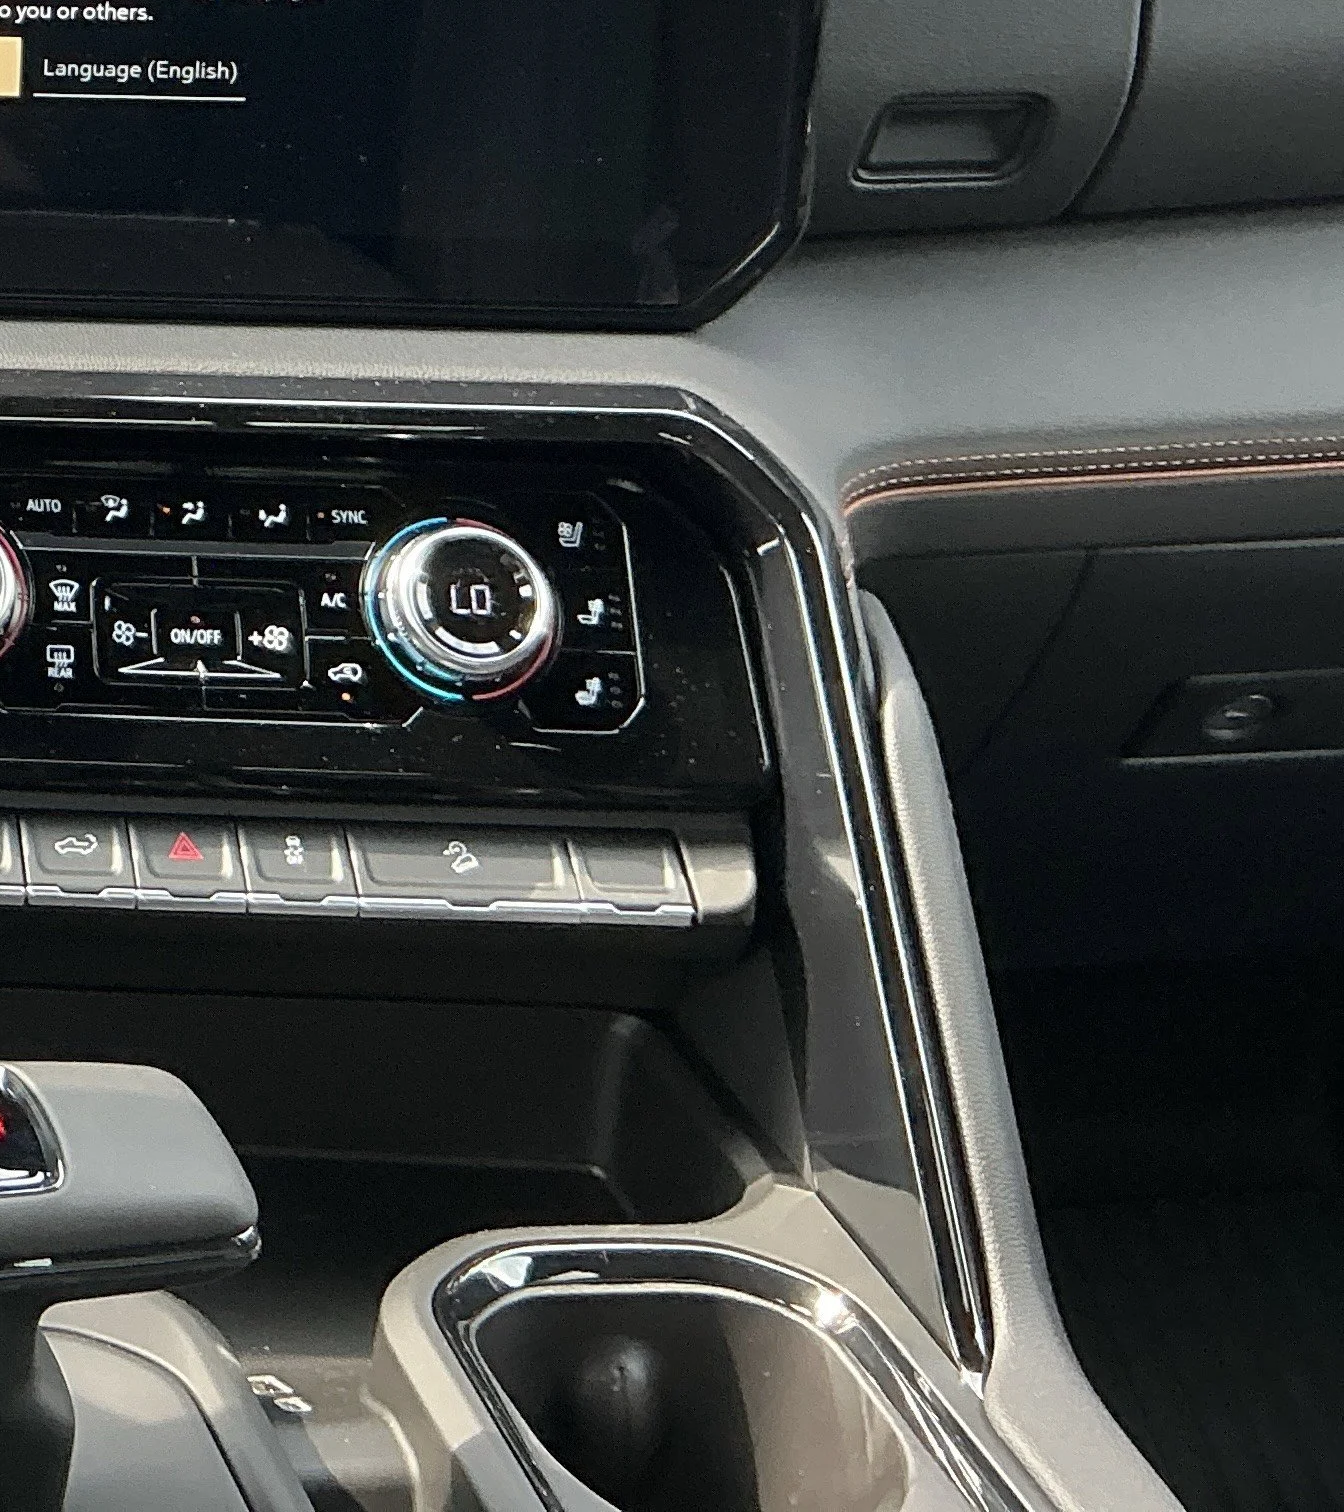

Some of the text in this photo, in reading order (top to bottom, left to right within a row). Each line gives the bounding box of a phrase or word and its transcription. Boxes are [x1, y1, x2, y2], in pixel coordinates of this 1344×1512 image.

[14, 4, 52, 24] you
[56, 5, 79, 20] or
[82, 1, 154, 21] others.
[43, 58, 239, 84] Language (English)
[26, 498, 62, 513] AUTO
[331, 509, 368, 525] SYNC
[53, 600, 77, 613] MAX
[320, 592, 348, 608] A/C
[169, 627, 222, 645] ON/OFF
